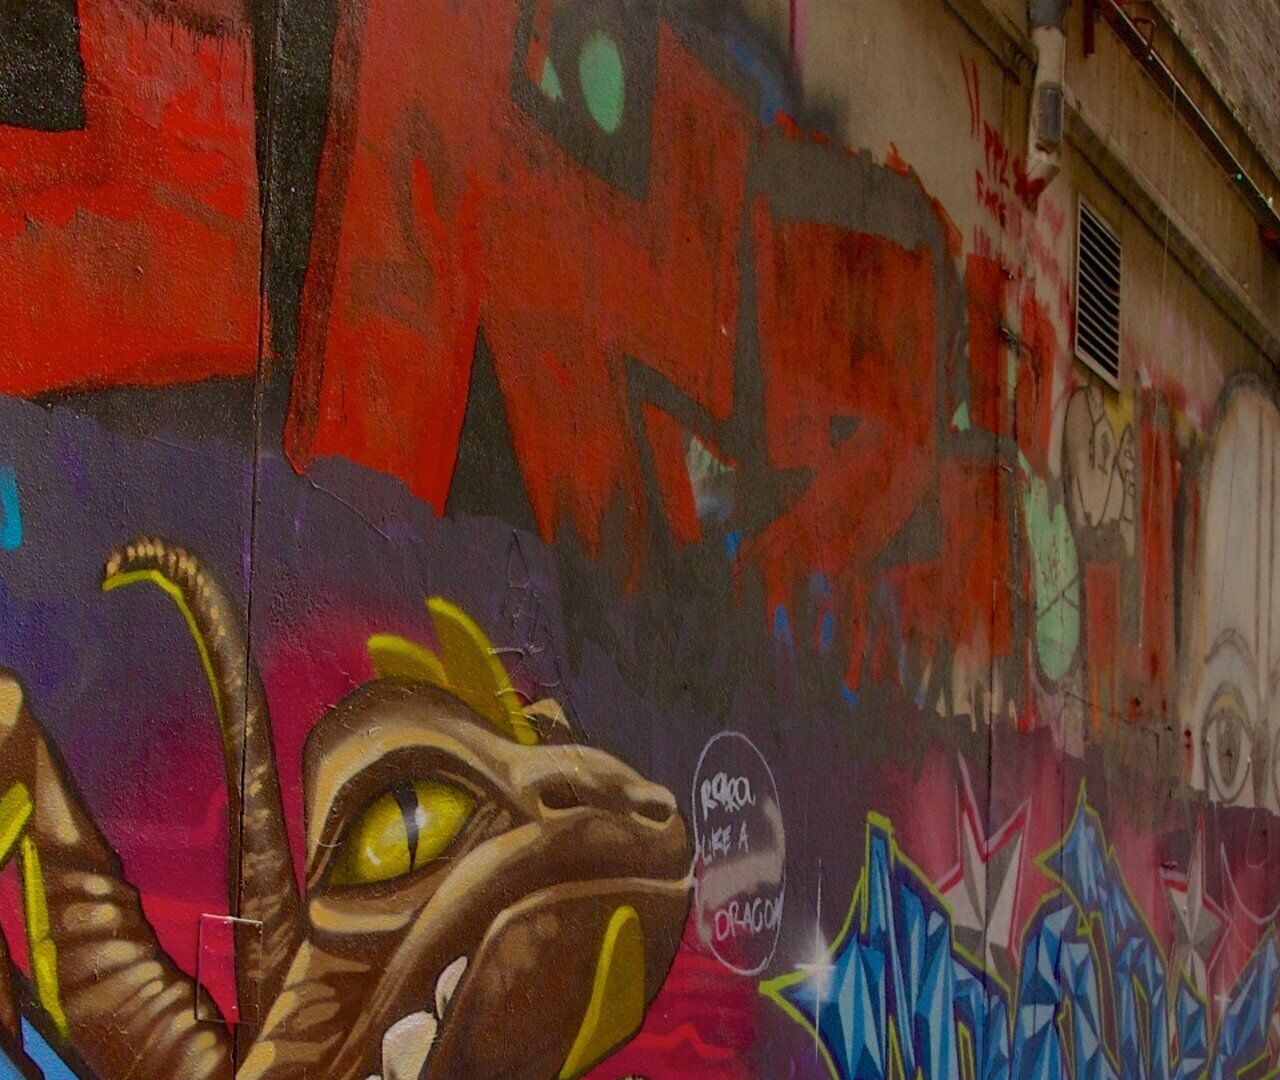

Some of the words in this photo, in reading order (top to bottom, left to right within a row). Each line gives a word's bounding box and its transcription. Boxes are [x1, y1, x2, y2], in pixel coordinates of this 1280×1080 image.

[701, 824, 732, 866] LIKE
[738, 820, 749, 853] A
[715, 893, 783, 941] DRAGON
